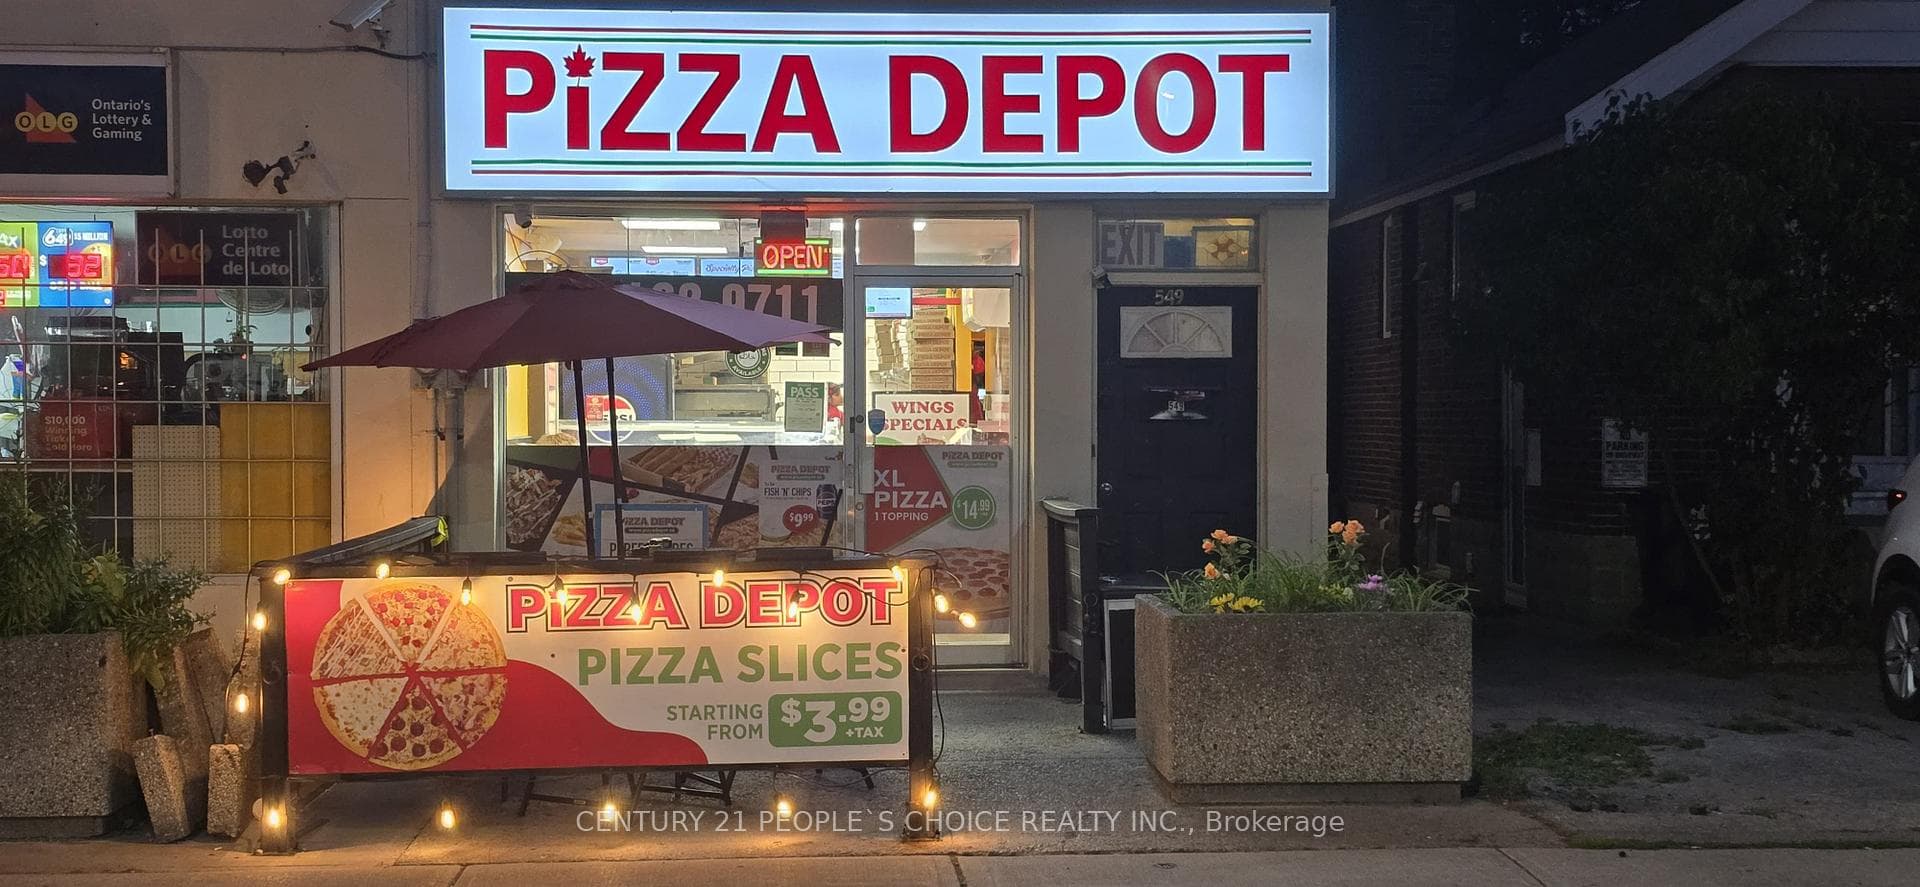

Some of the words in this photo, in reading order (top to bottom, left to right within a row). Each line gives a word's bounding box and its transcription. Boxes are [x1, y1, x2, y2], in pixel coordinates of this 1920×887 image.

[91, 99, 151, 111] Ontario's
[888, 52, 1290, 154] DEPOT
[18, 115, 74, 129] OLG
[92, 113, 138, 127] Lottery
[141, 114, 152, 125] &
[92, 127, 142, 141] Gaming
[222, 225, 268, 239] Lotto
[222, 243, 280, 257] Centre
[1103, 225, 1161, 266] EXIT
[762, 245, 824, 270] OPEN
[222, 261, 243, 275] de
[251, 261, 289, 275] Loto
[1155, 289, 1184, 305] 549
[732, 365, 762, 376] AVAILABLE
[790, 387, 819, 398] PASS
[891, 401, 954, 414] WINGS
[884, 418, 967, 431] SPECIALS
[972, 452, 1004, 460] DEPOT
[874, 470, 905, 487] XL
[764, 488, 780, 496] FISH
[791, 488, 811, 496] CHIPS
[875, 491, 947, 508] PIZZA
[875, 512, 879, 520] 1
[881, 512, 928, 521] TOPPING
[700, 579, 902, 629] DEPOT
[578, 646, 723, 686] PIZZA
[737, 641, 903, 682] SLICES
[666, 703, 763, 721] STARTING
[781, 697, 891, 743] $3.99
[707, 723, 763, 740] FROM
[845, 726, 884, 738] +TAX
